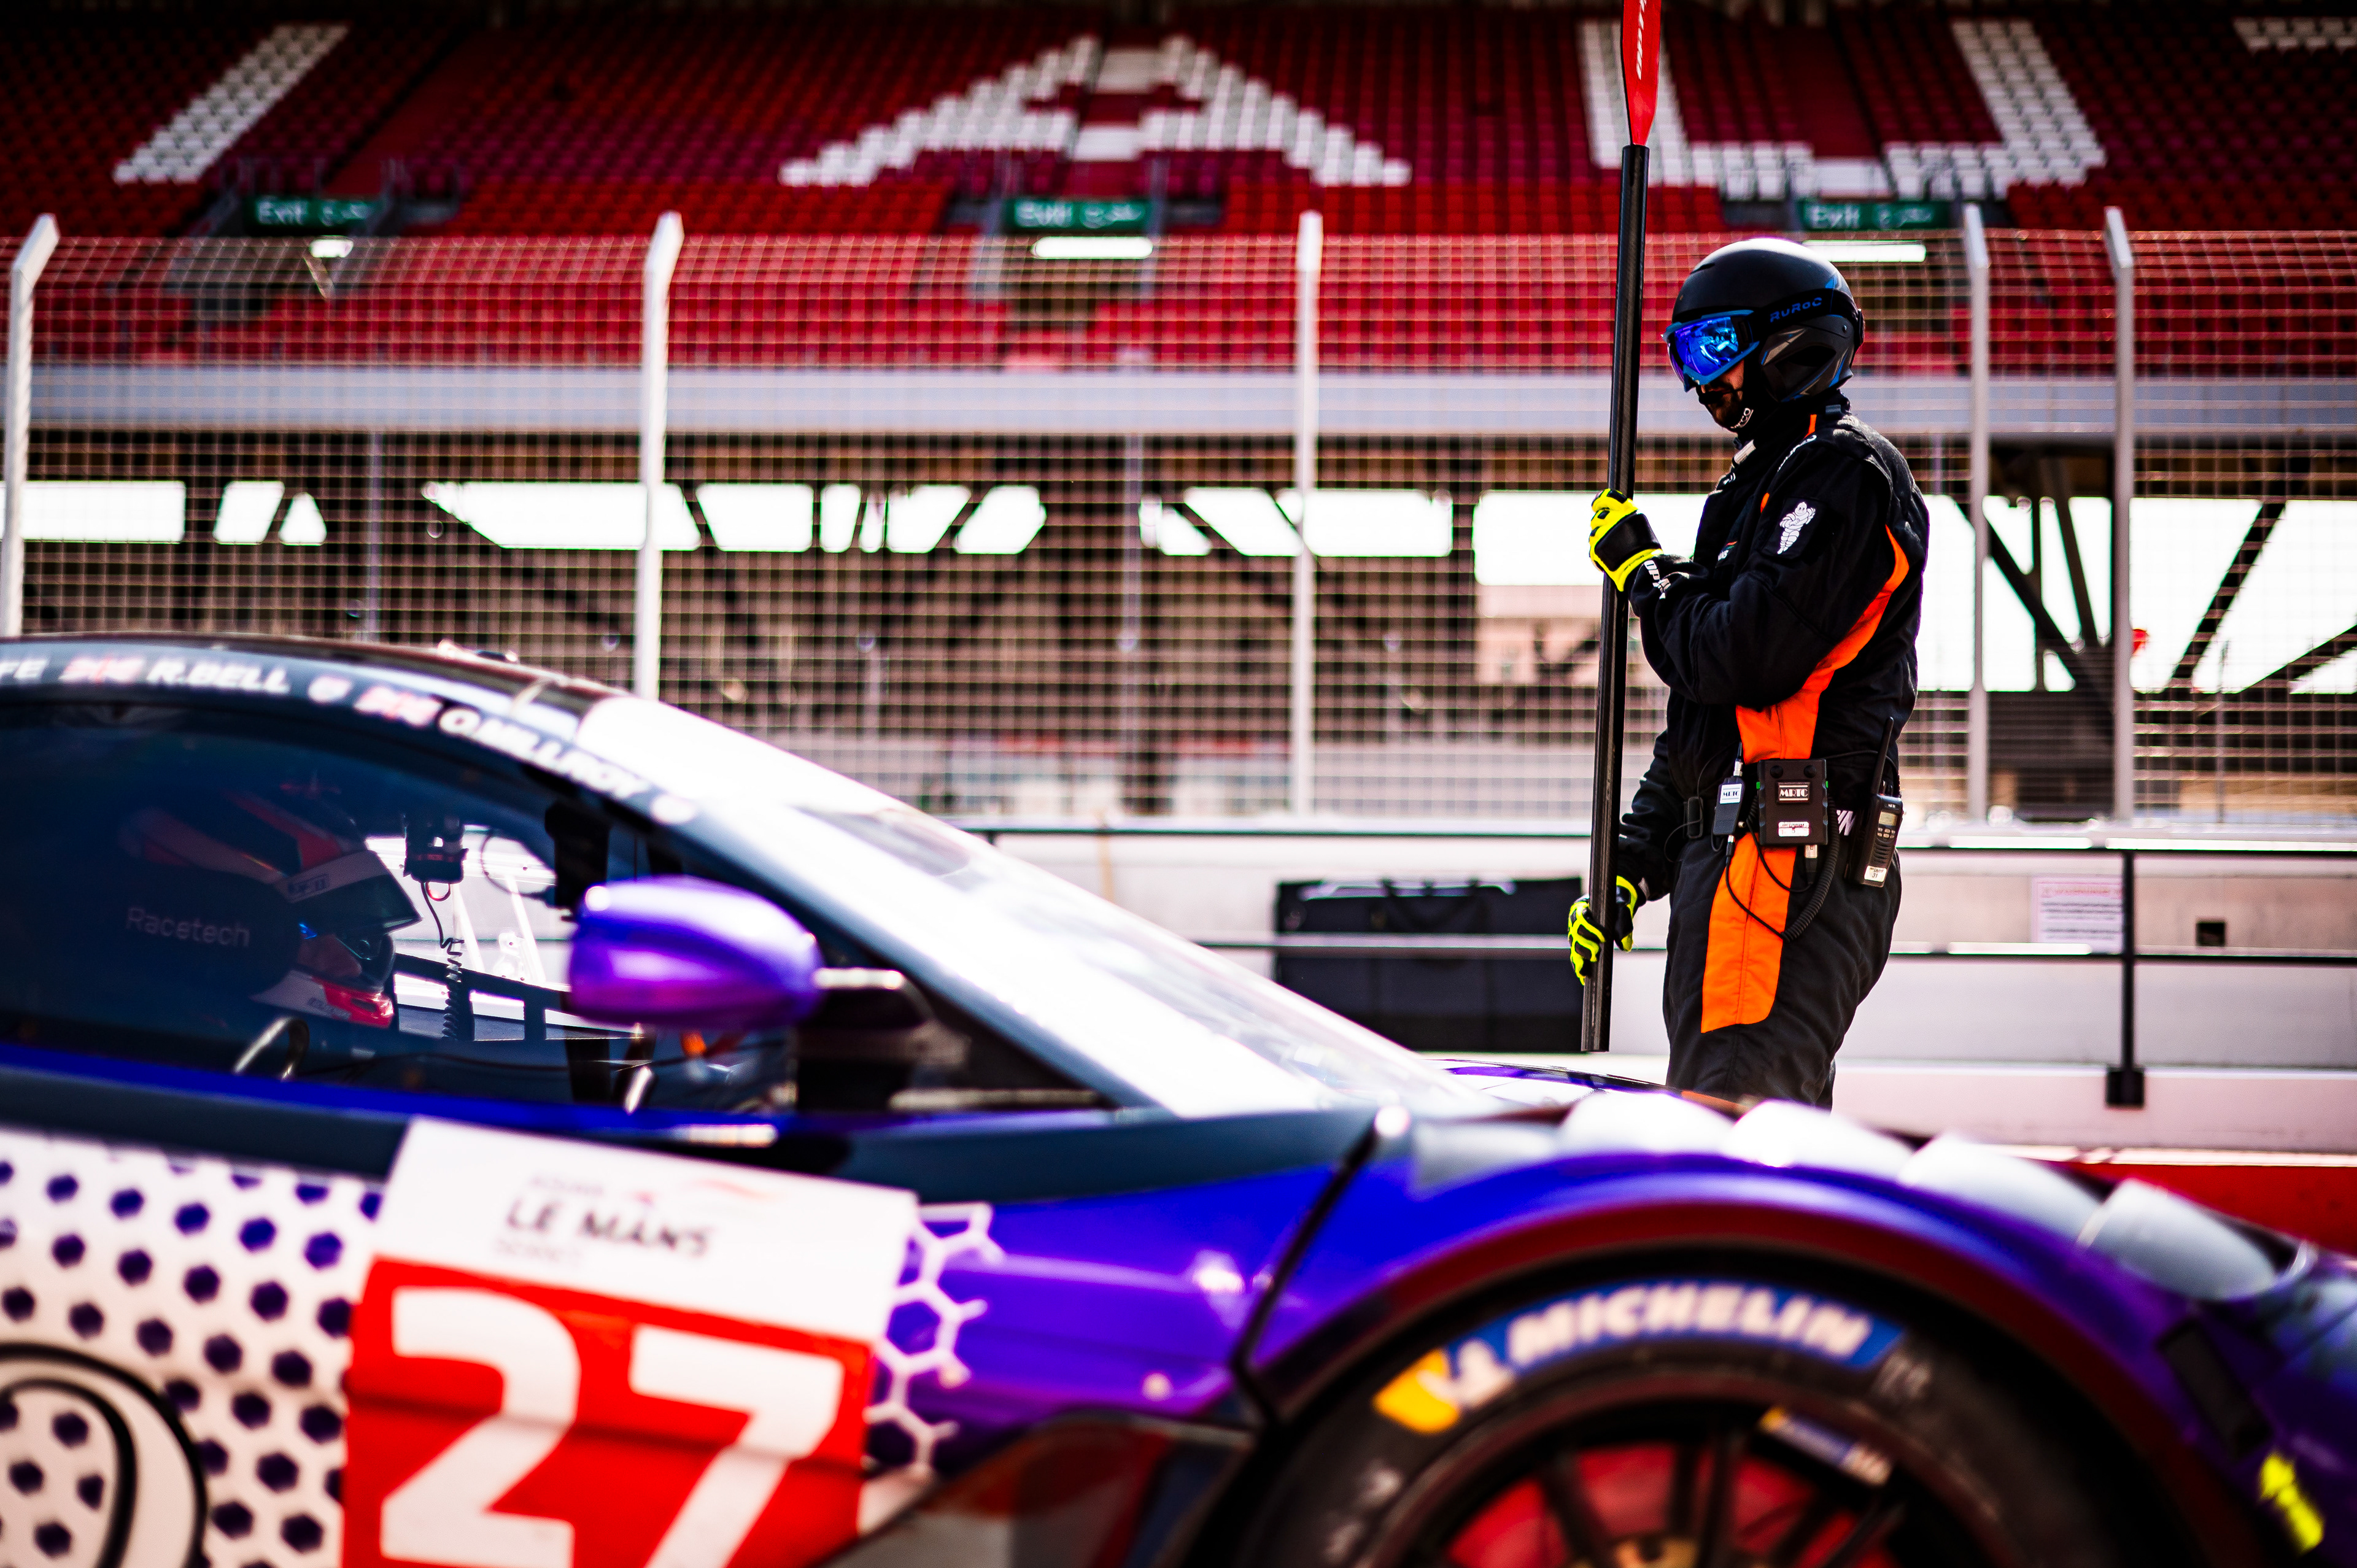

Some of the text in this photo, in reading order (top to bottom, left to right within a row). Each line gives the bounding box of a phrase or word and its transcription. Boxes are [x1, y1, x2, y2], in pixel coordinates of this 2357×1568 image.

[1779, 789, 1808, 797] MRTC
[125, 906, 250, 948] Racetech
[505, 1197, 563, 1231] LE
[578, 1210, 713, 1258] MANS
[1507, 1281, 1873, 1360] MICHELIN
[379, 1285, 846, 1568] 27
